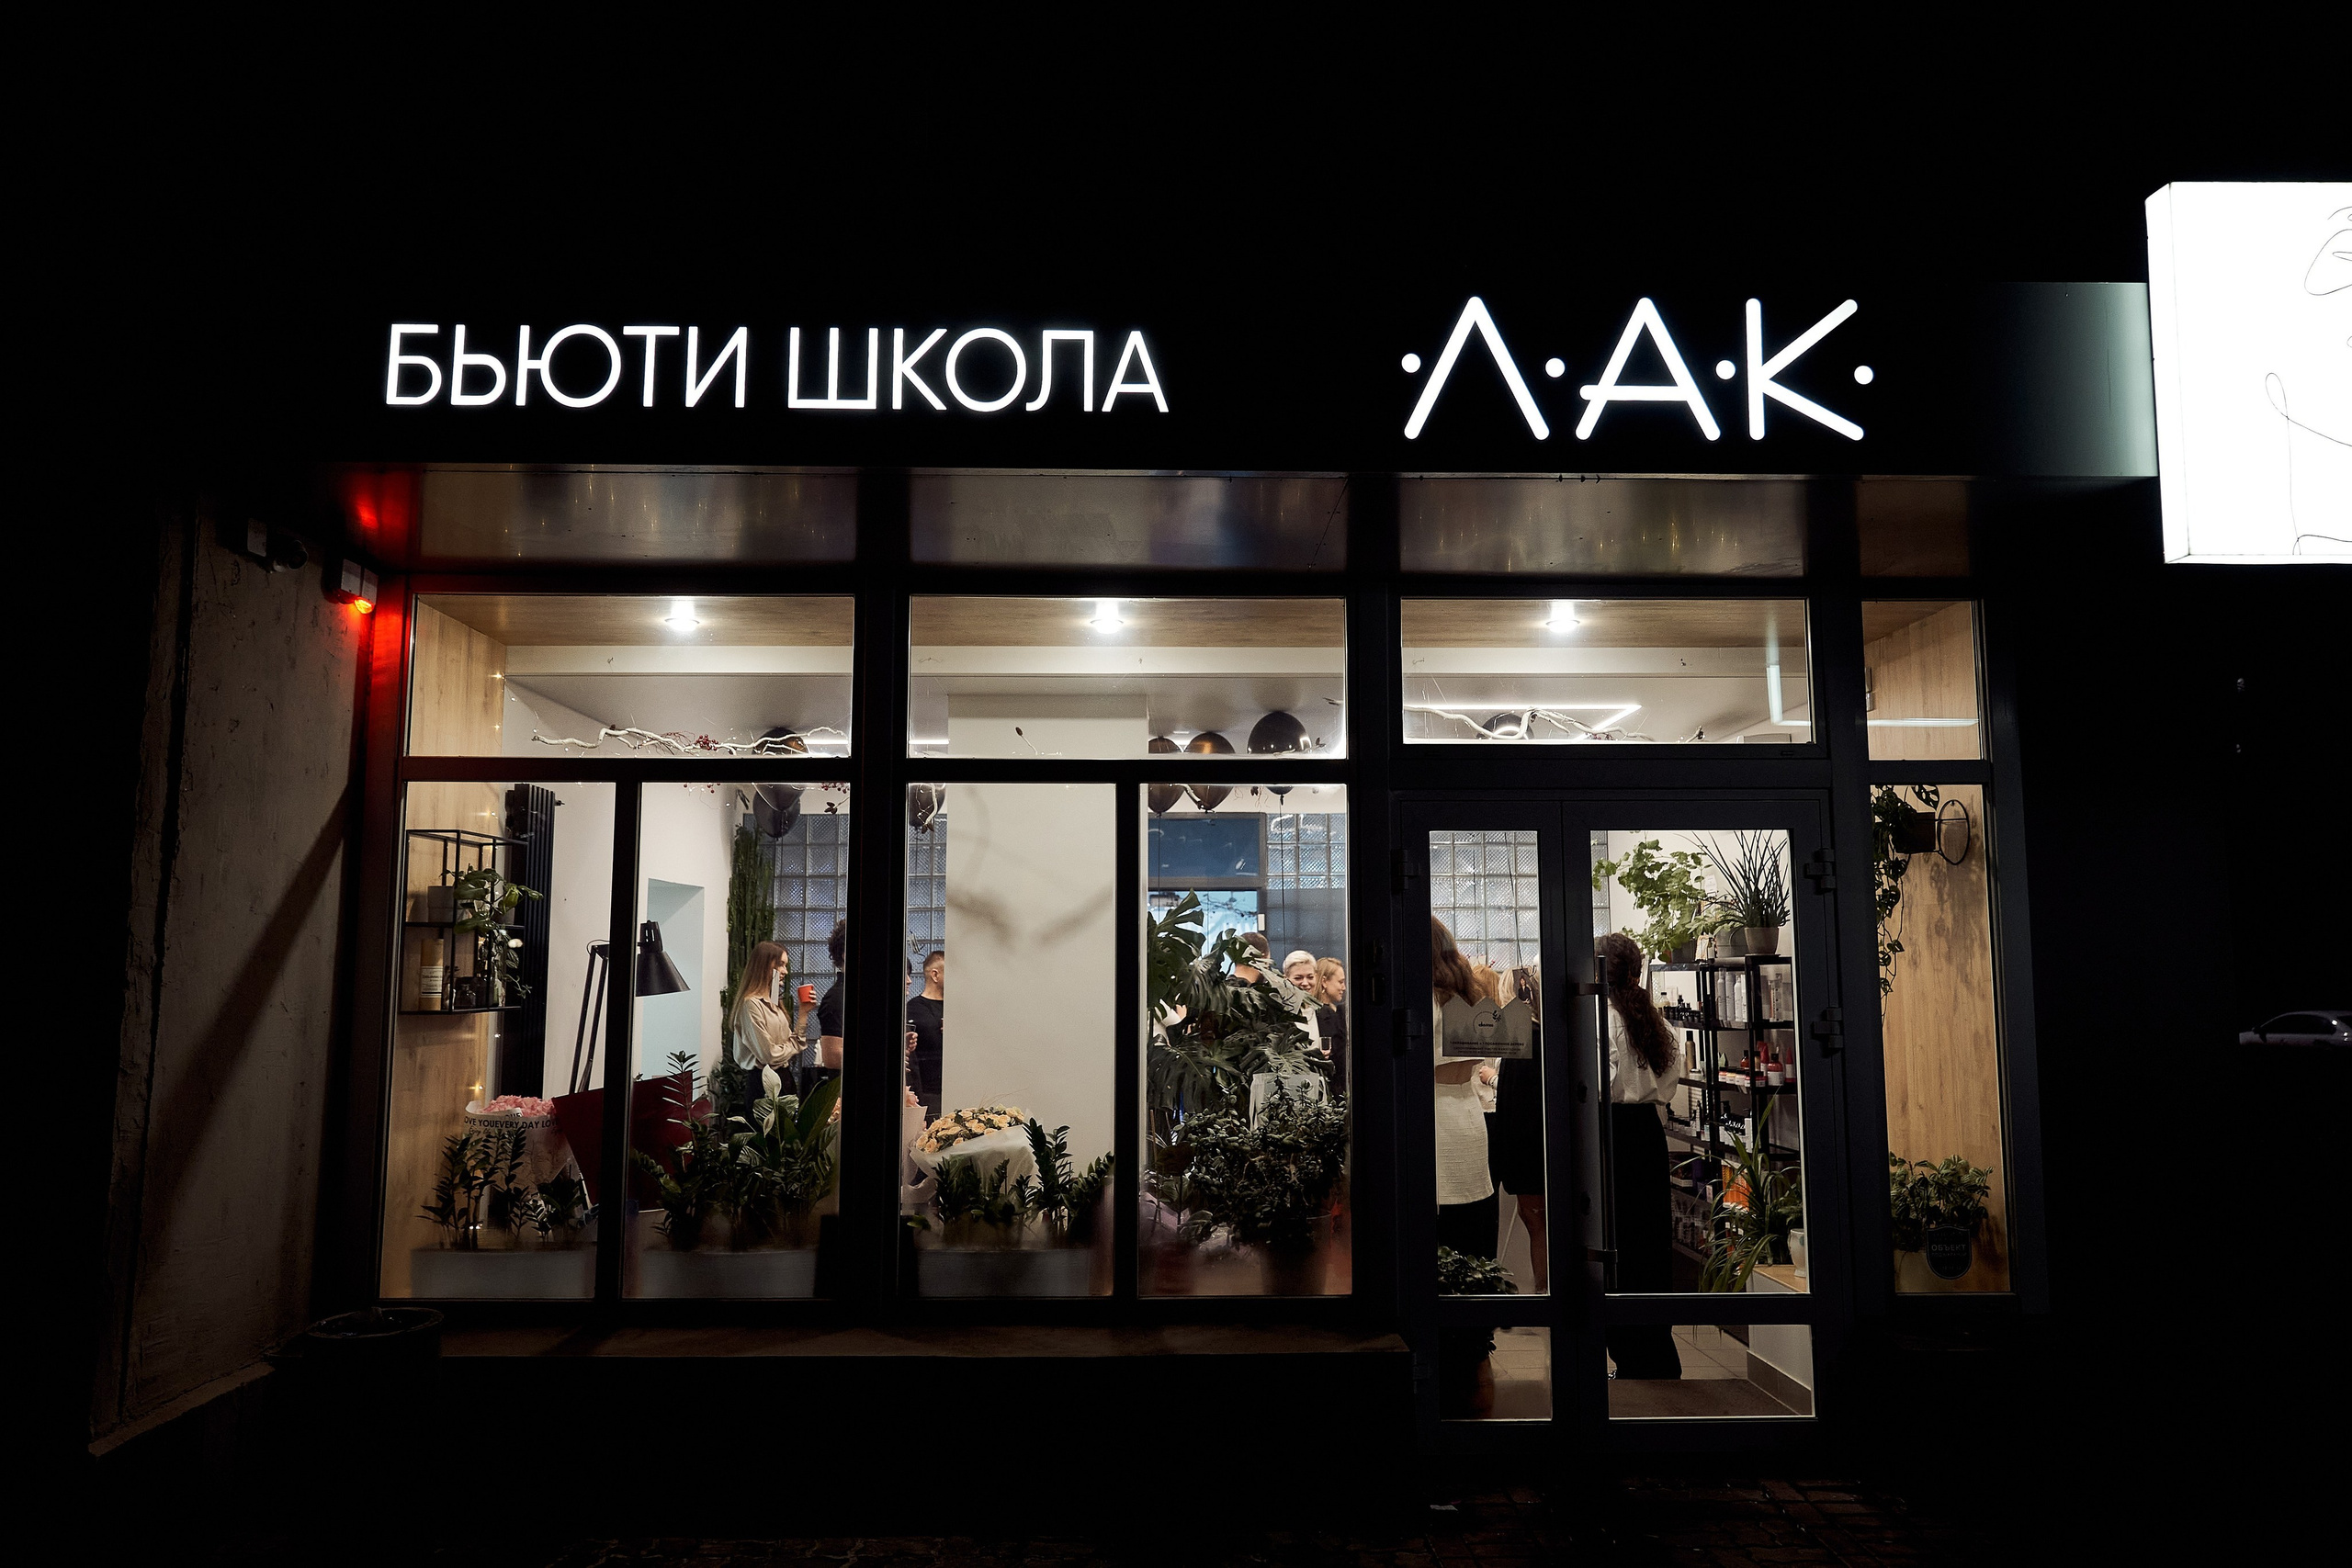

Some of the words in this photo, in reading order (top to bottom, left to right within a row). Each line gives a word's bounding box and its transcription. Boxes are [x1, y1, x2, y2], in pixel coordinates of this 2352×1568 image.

[386, 323, 747, 408] БЬЮТИ
[787, 327, 1169, 412] ШКОЛА
[522, 1121, 539, 1130] DAY
[1931, 1244, 1966, 1252] ОБЪЕКТ
